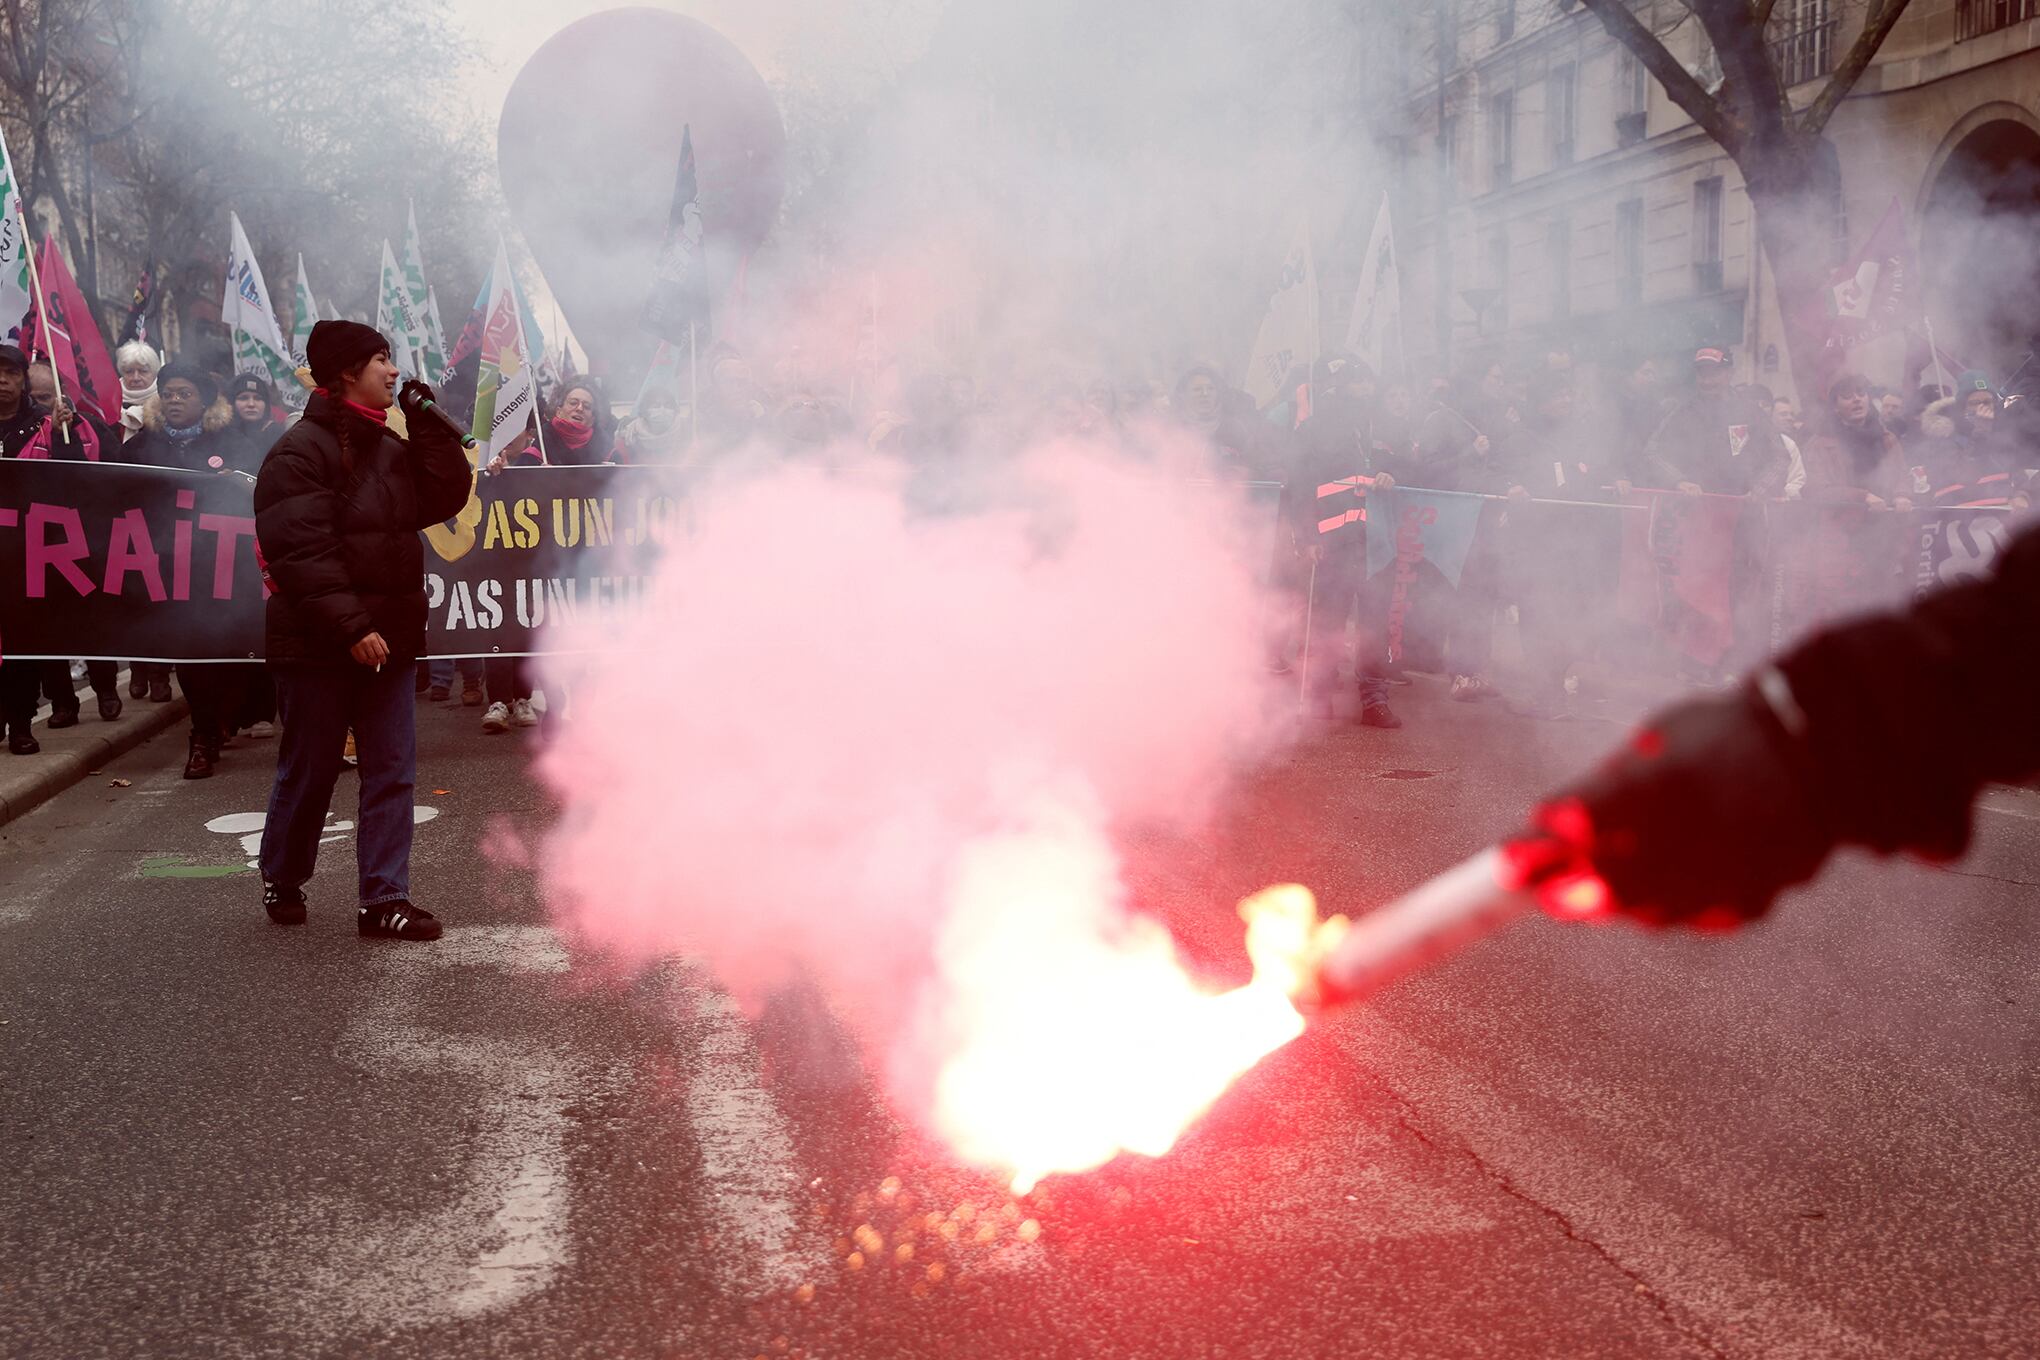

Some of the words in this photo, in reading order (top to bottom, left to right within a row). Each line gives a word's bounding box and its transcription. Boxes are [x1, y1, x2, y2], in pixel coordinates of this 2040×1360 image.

[552, 497, 613, 548] UN
[424, 573, 504, 631] PAS
[515, 578, 577, 628] UN
